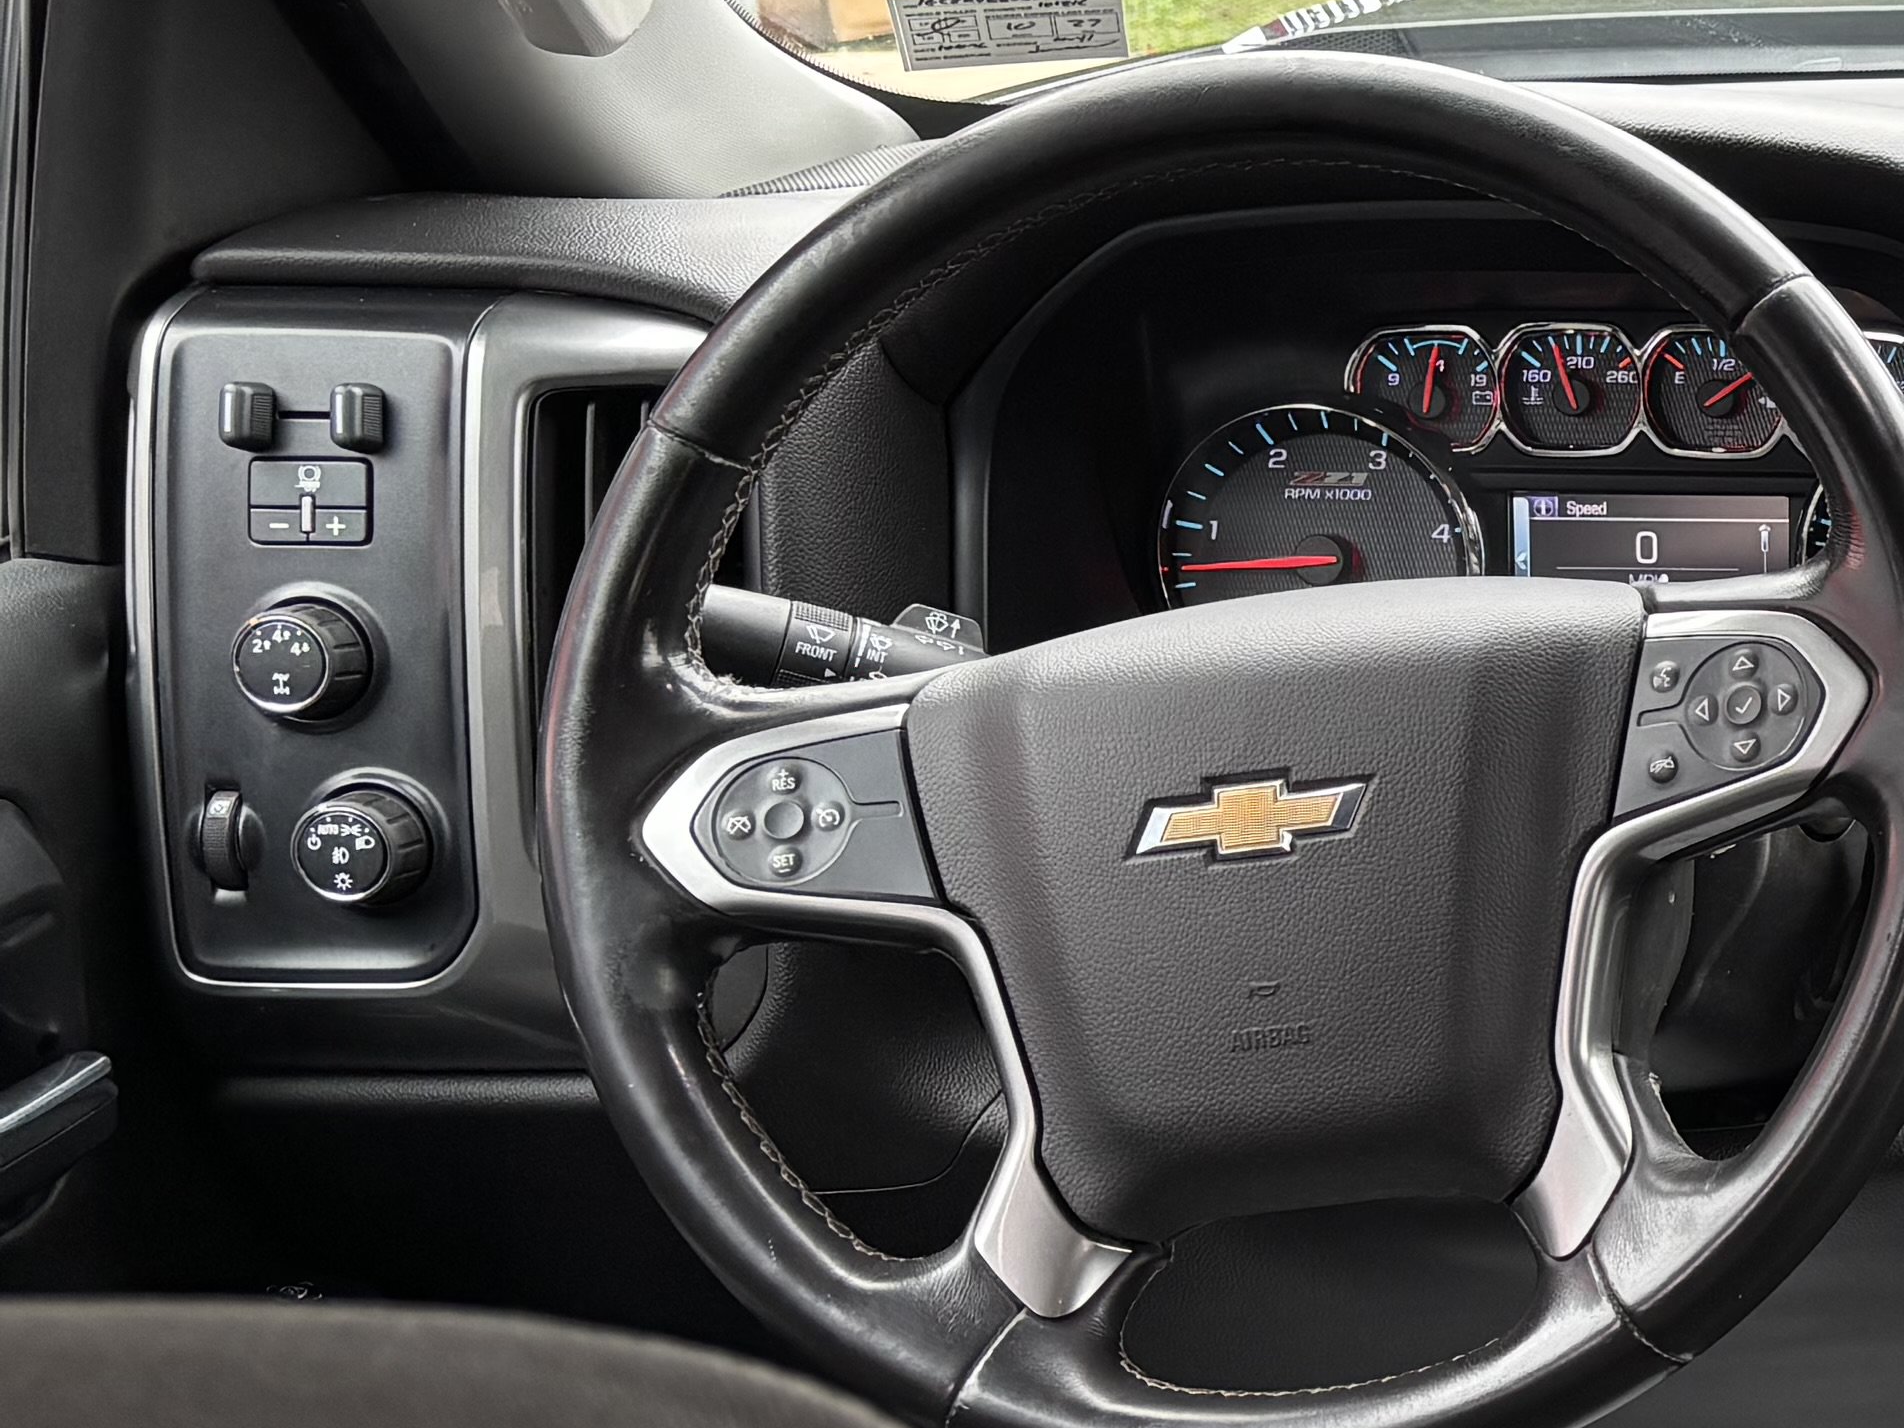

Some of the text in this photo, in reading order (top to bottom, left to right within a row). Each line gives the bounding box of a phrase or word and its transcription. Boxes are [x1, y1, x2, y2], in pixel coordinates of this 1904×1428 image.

[1567, 357, 1594, 369] 210
[1711, 359, 1734, 371] 1/2
[1388, 373, 1399, 387] 9
[1470, 373, 1487, 387] 19
[1522, 369, 1551, 382] 160
[1675, 372, 1685, 386] E
[1269, 448, 1287, 468] 2
[1370, 450, 1386, 470] 3
[1288, 473, 1368, 486] Z71
[1284, 489, 1371, 501] RPM x1000
[1566, 500, 1607, 518] Speed
[1208, 521, 1218, 540] 1
[1431, 525, 1450, 543] 4
[1636, 532, 1657, 564] 0
[795, 642, 837, 661] FRONT
[866, 649, 888, 661] INT
[771, 776, 796, 792] RES
[772, 853, 795, 869] SET
[1229, 1023, 1311, 1052] AIRBAG
